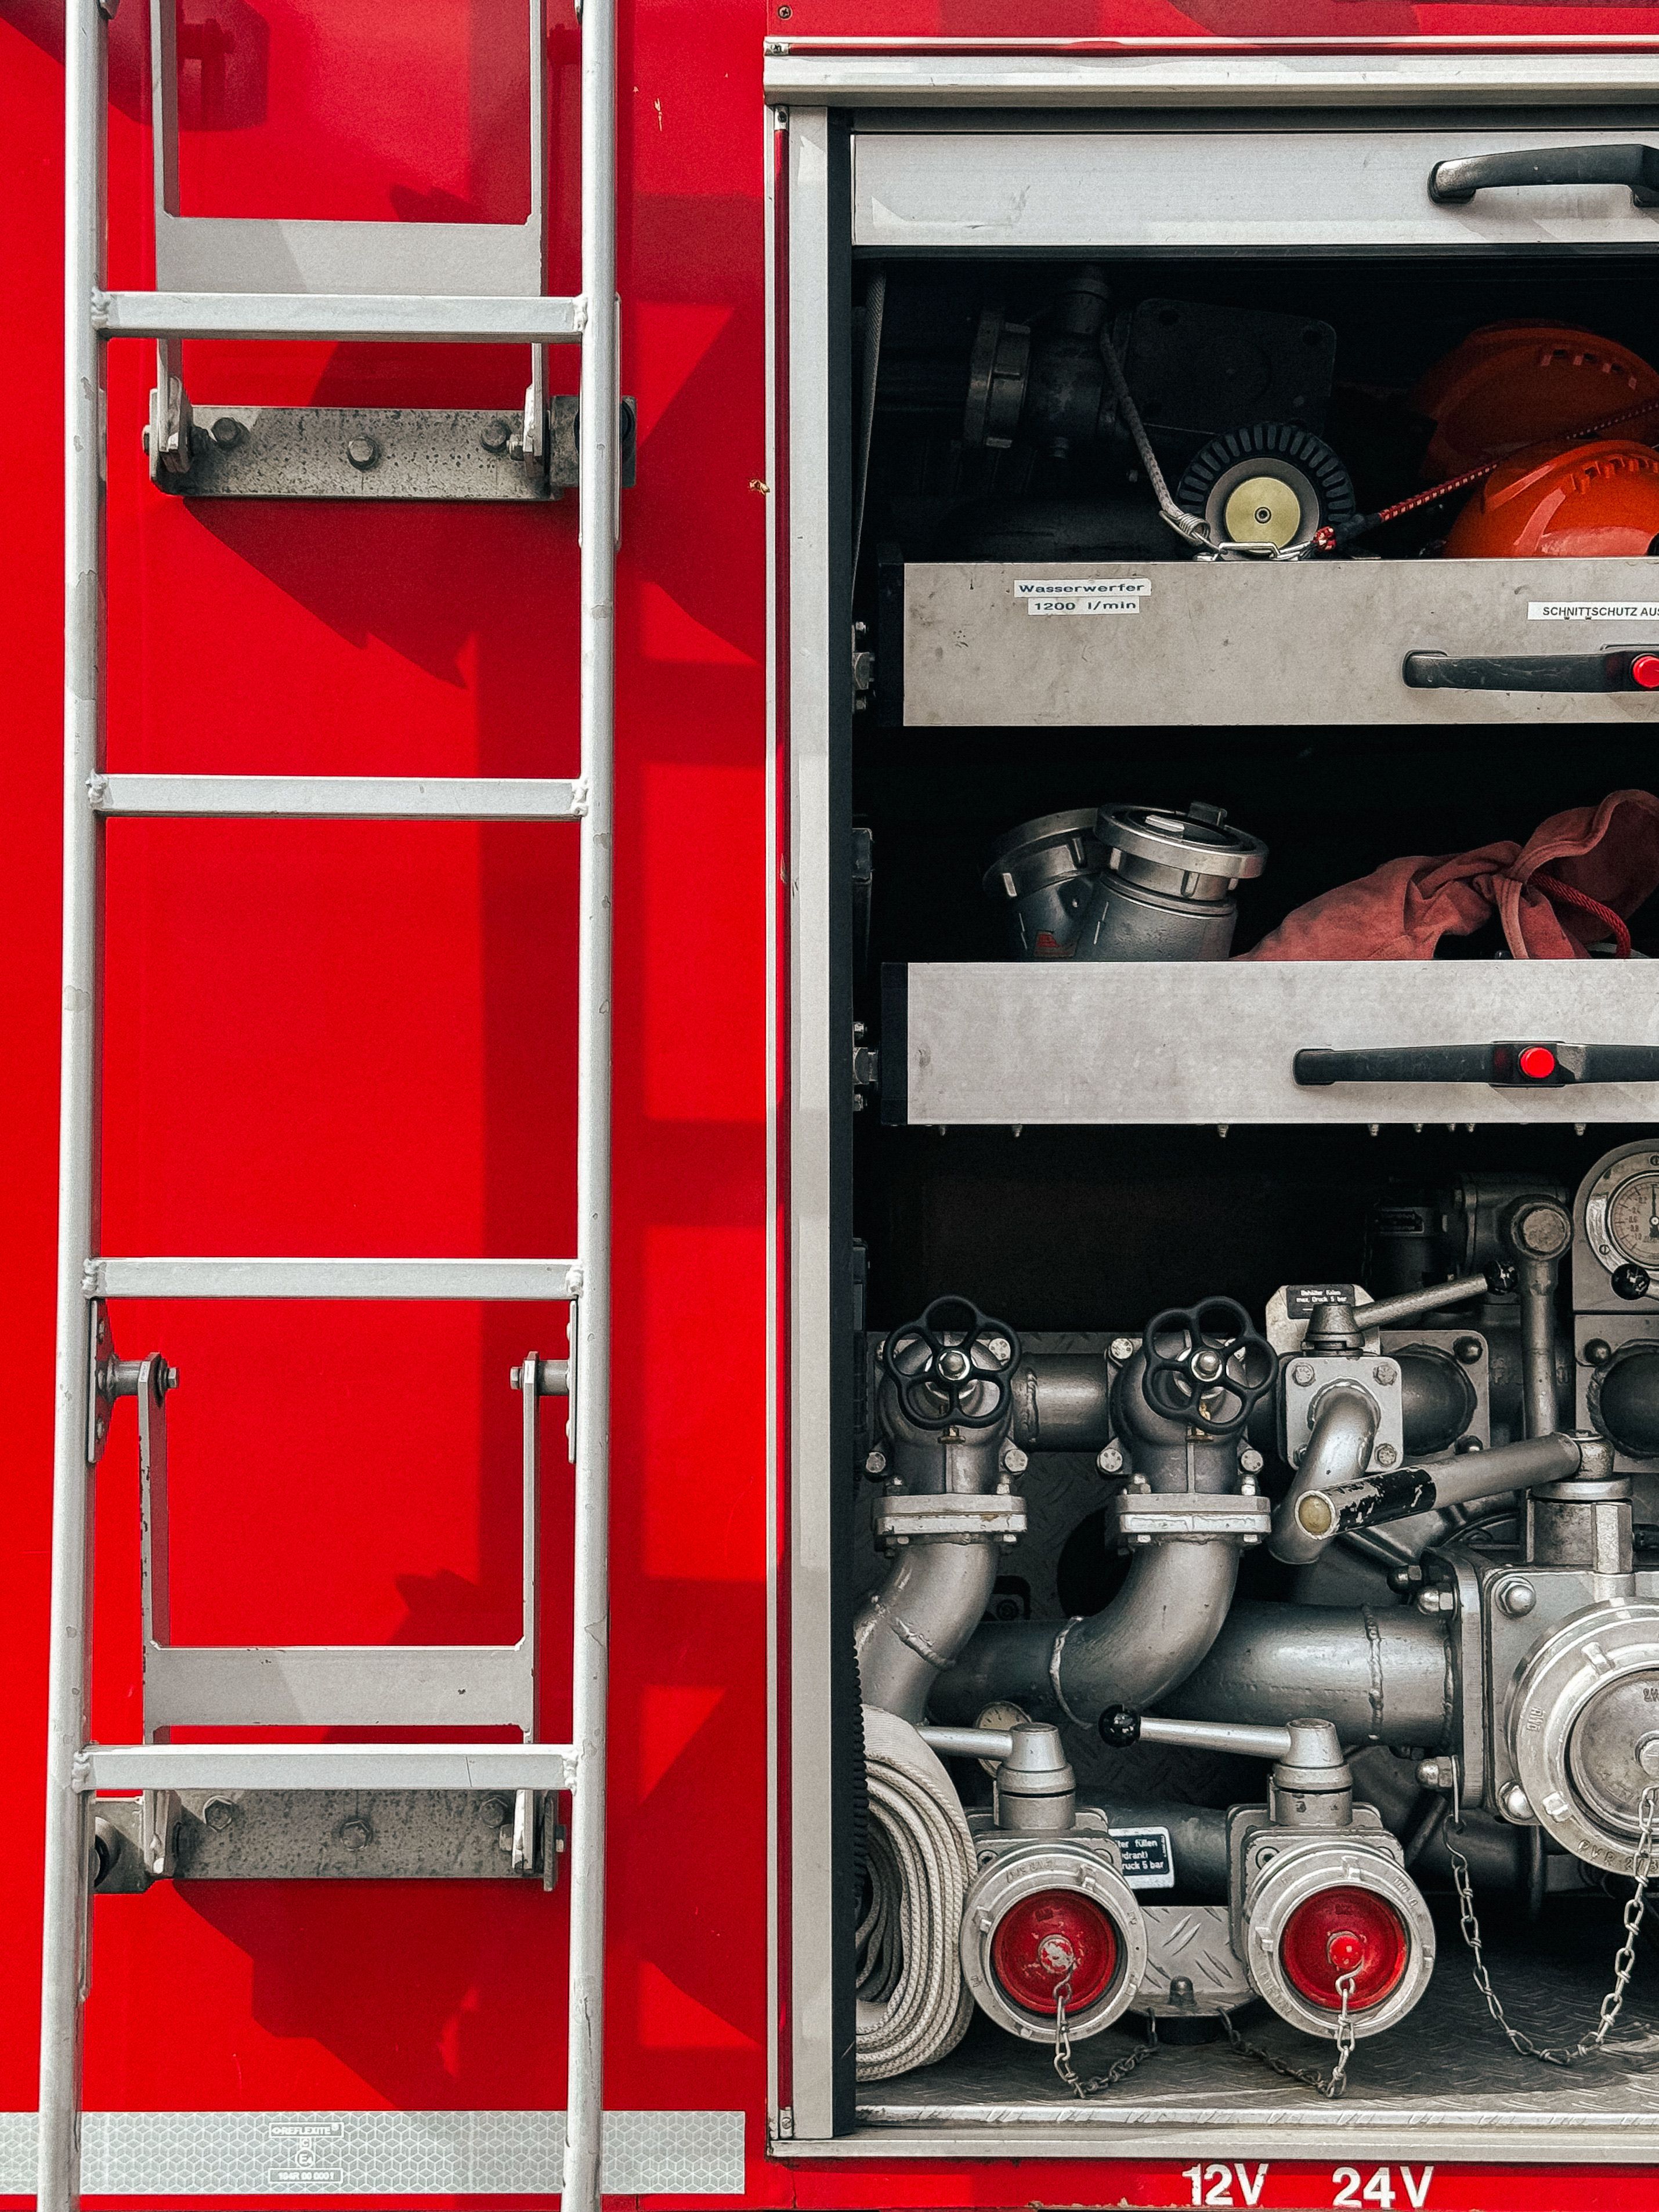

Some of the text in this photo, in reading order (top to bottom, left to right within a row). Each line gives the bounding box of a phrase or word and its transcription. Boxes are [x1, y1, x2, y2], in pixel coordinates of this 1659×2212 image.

[1018, 584, 1144, 593] Wasserwerfer
[1035, 601, 1136, 610] 1200 l/min
[1542, 607, 1637, 616] SCHNITTSCHUTZ
[1134, 1839, 1158, 1848] füllen
[1141, 1861, 1148, 1870] 5
[1150, 1860, 1164, 1870] bar
[1181, 2163, 1434, 2209] 12V 24V
